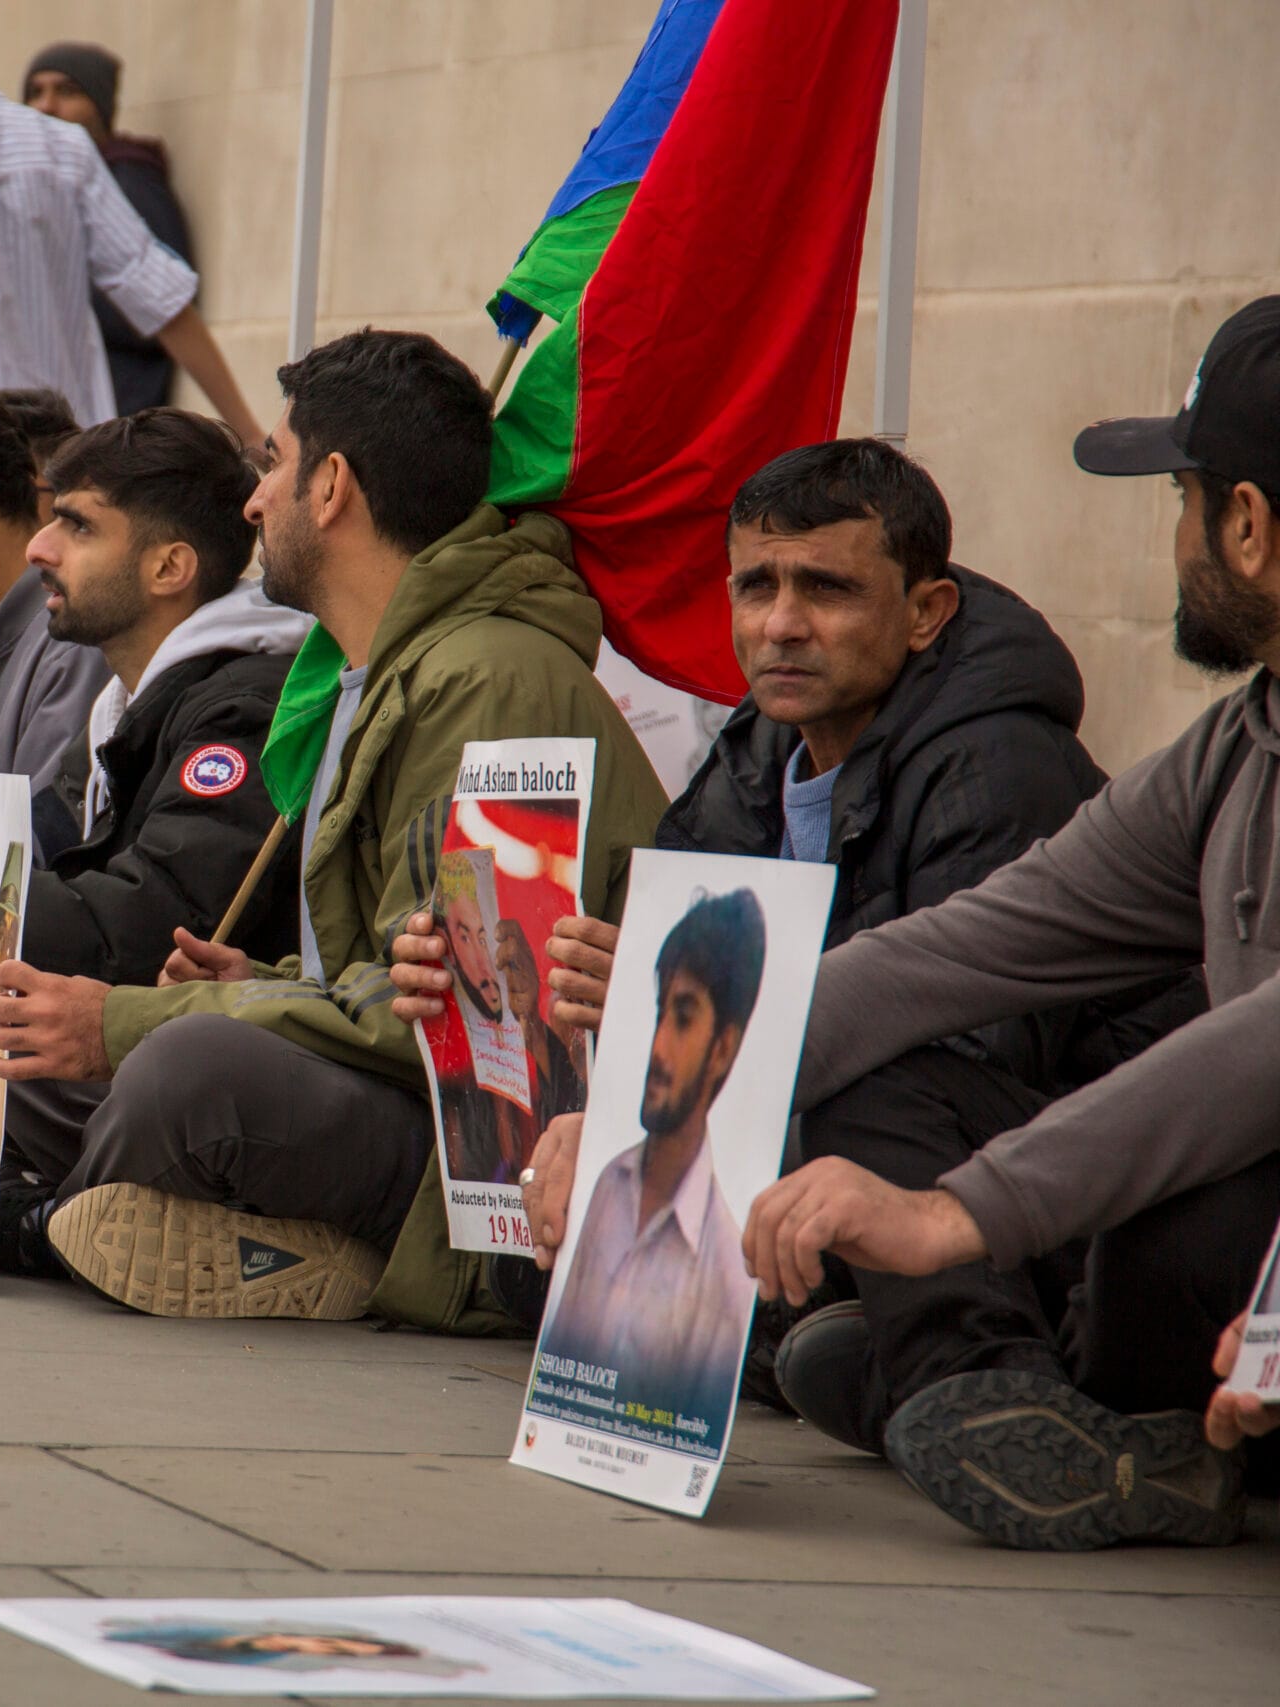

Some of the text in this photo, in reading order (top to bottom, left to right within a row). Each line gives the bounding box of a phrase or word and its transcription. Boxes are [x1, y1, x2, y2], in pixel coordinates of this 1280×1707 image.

[521, 761, 577, 792] baloch
[451, 1190, 487, 1206] Abducted
[488, 1192, 497, 1210] by
[488, 1214, 508, 1244] 19
[250, 1251, 276, 1265] NIKE
[539, 1352, 619, 1390] SHOAIB BALOCH
